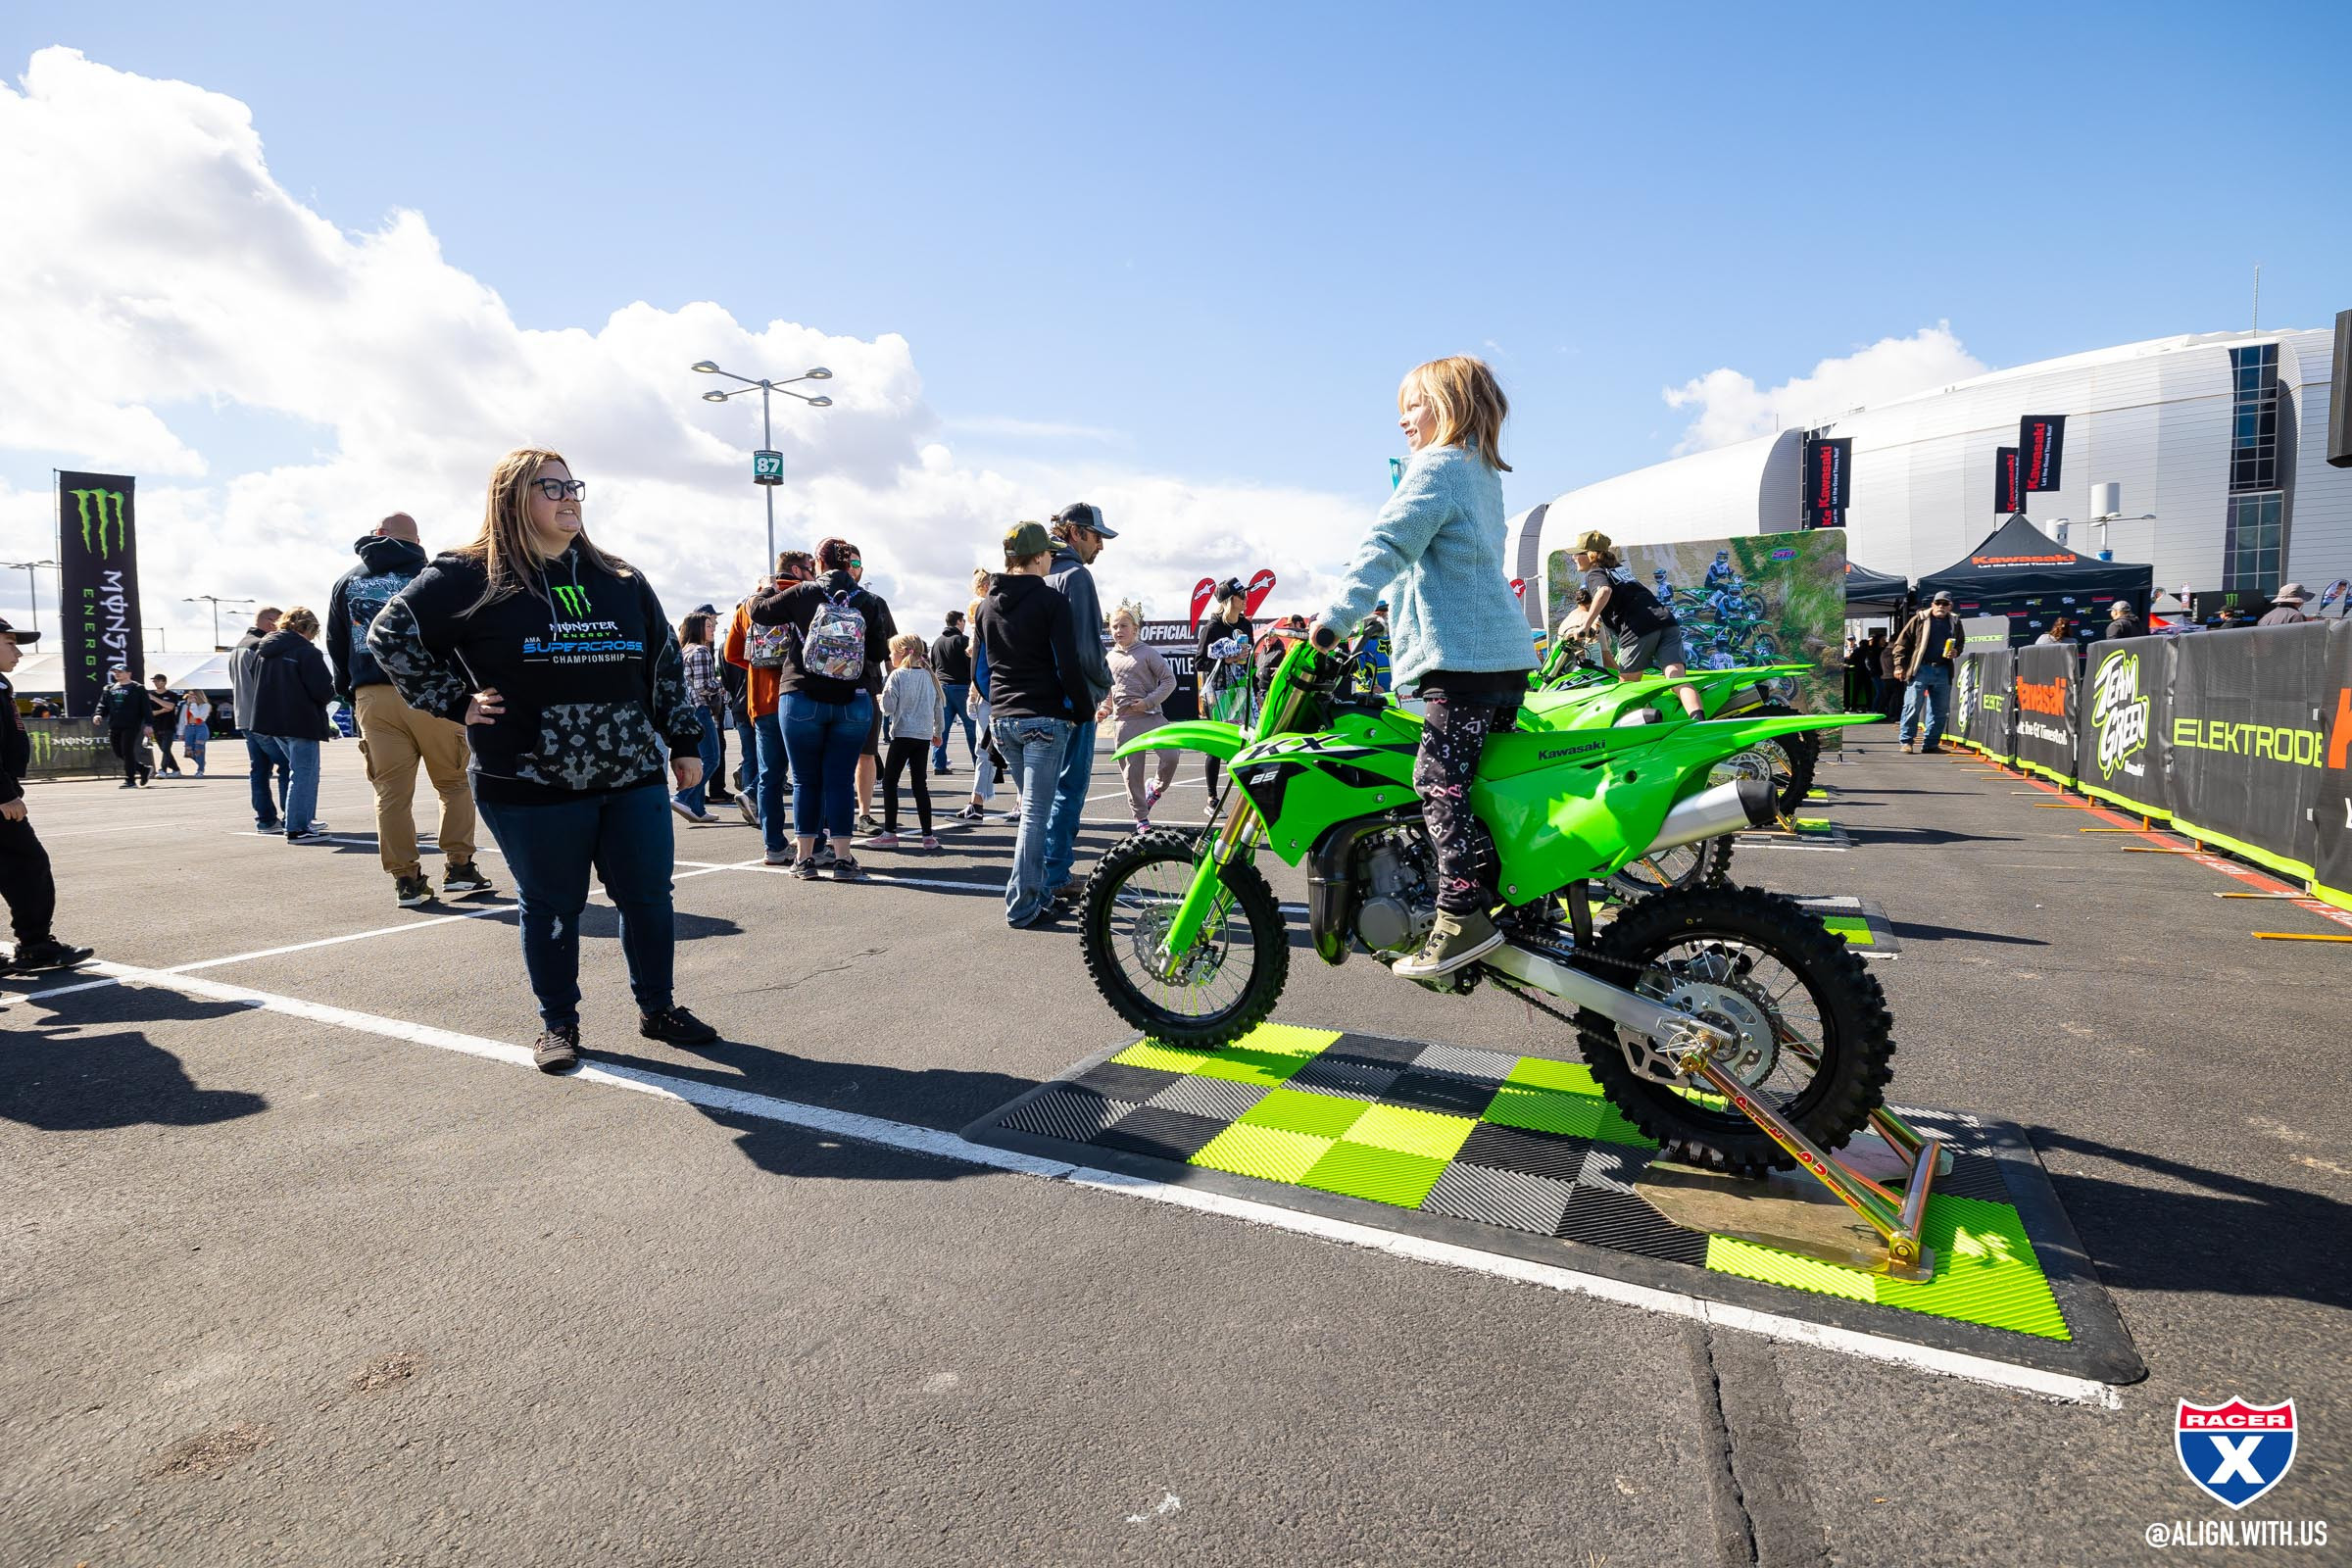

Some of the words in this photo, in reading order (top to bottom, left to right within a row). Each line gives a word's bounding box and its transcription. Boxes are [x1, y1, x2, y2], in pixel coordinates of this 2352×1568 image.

[757, 457, 780, 473] 87
[2027, 422, 2045, 489] Kawasaki
[1818, 446, 1833, 508] Kawasaki
[2006, 454, 2015, 512] Kawasaki
[1971, 554, 2077, 564] Kawasaki
[83, 588, 97, 682] ENERGY
[99, 569, 130, 686] MONST
[549, 620, 618, 634] MONSTER
[1964, 634, 2004, 643] EKTRODE
[522, 640, 643, 654] SUPERCROSS
[553, 654, 625, 663] CHAMPIONSHIP
[2093, 655, 2136, 718] TEAM
[52, 736, 110, 747] MONSTE
[1246, 734, 1350, 760] KX
[2100, 700, 2148, 772] GREEN
[2173, 717, 2324, 769] ELEKTRODE
[1538, 739, 1606, 760] Kawasaki
[1250, 770, 1279, 785] 85
